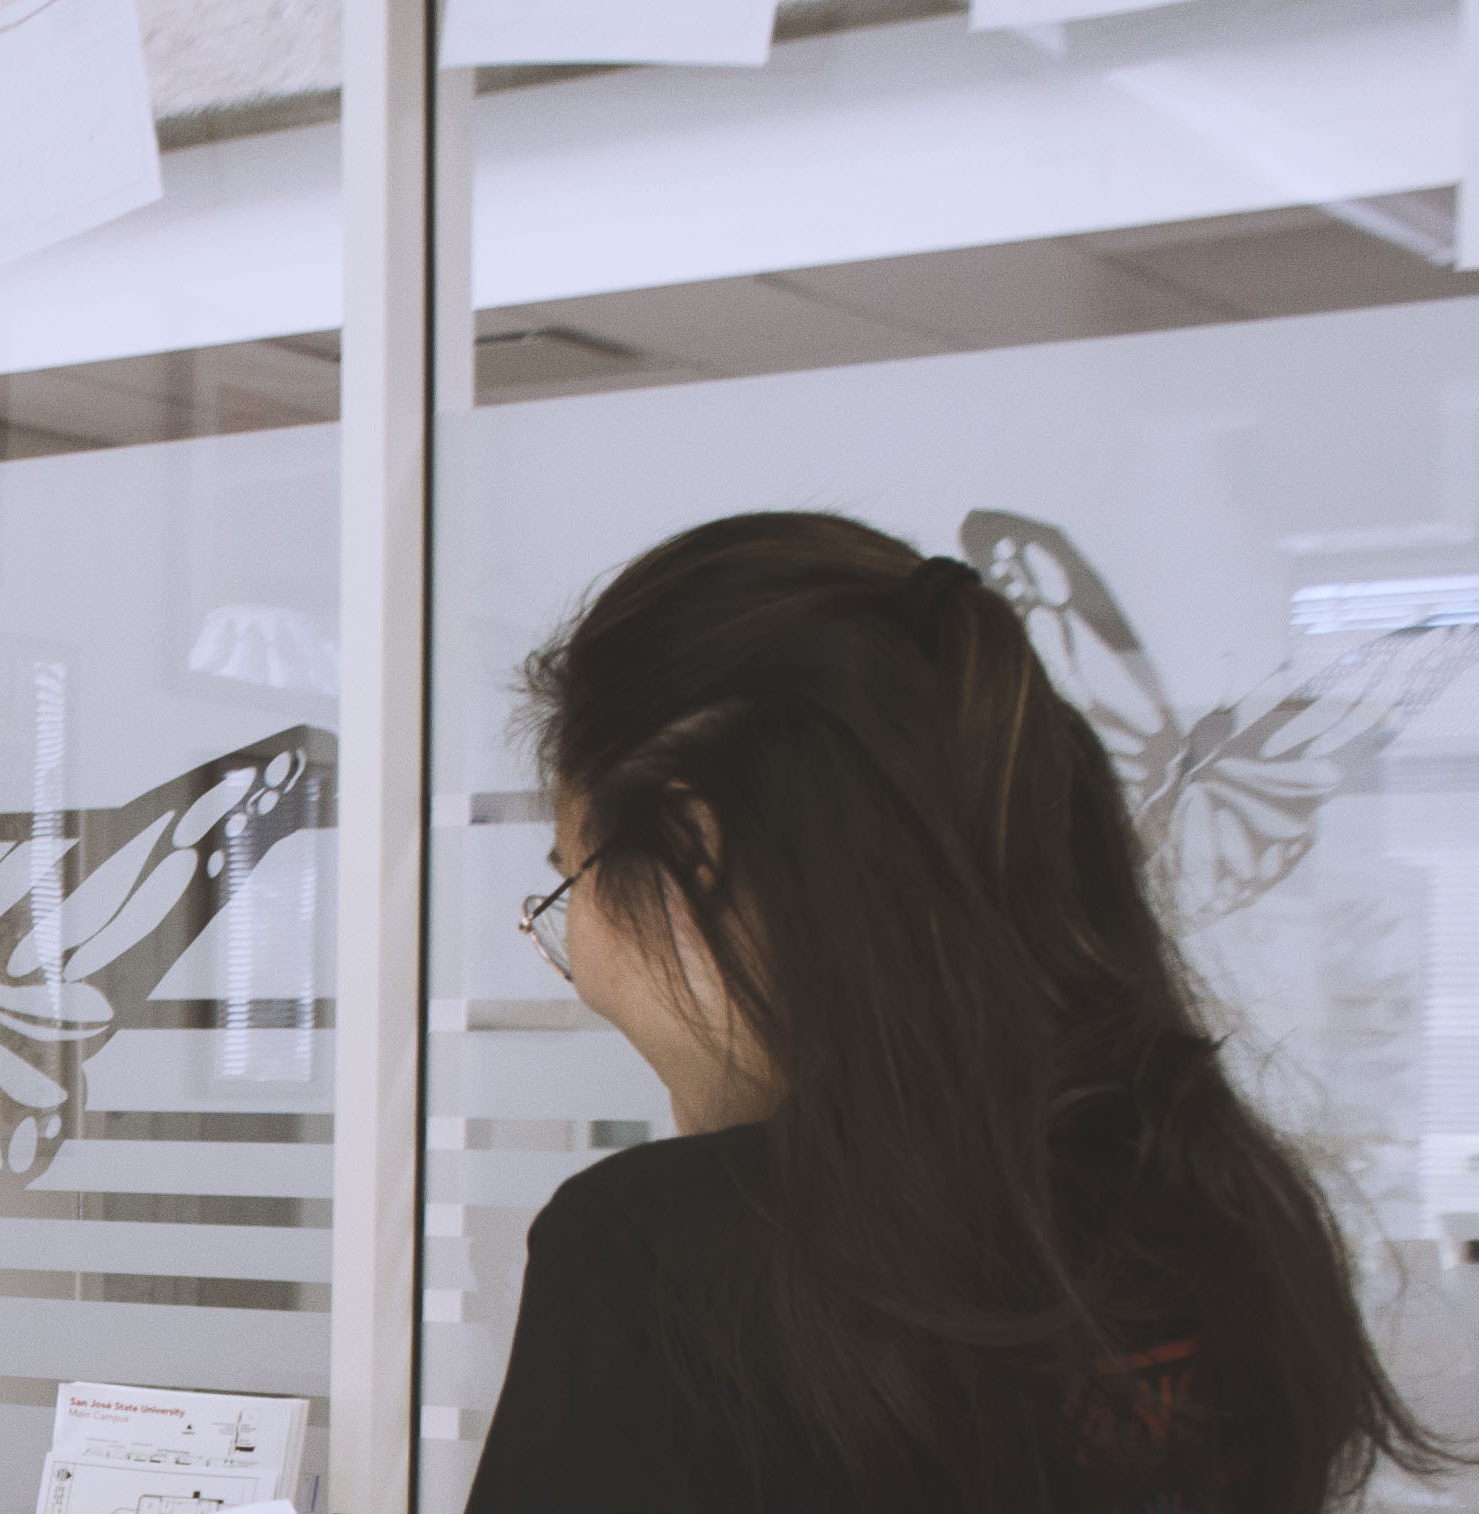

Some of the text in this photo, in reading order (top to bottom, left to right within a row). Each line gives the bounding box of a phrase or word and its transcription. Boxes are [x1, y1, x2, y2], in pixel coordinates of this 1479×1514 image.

[70, 1397, 87, 1406] San
[114, 1402, 137, 1412] State
[140, 1405, 185, 1418] University
